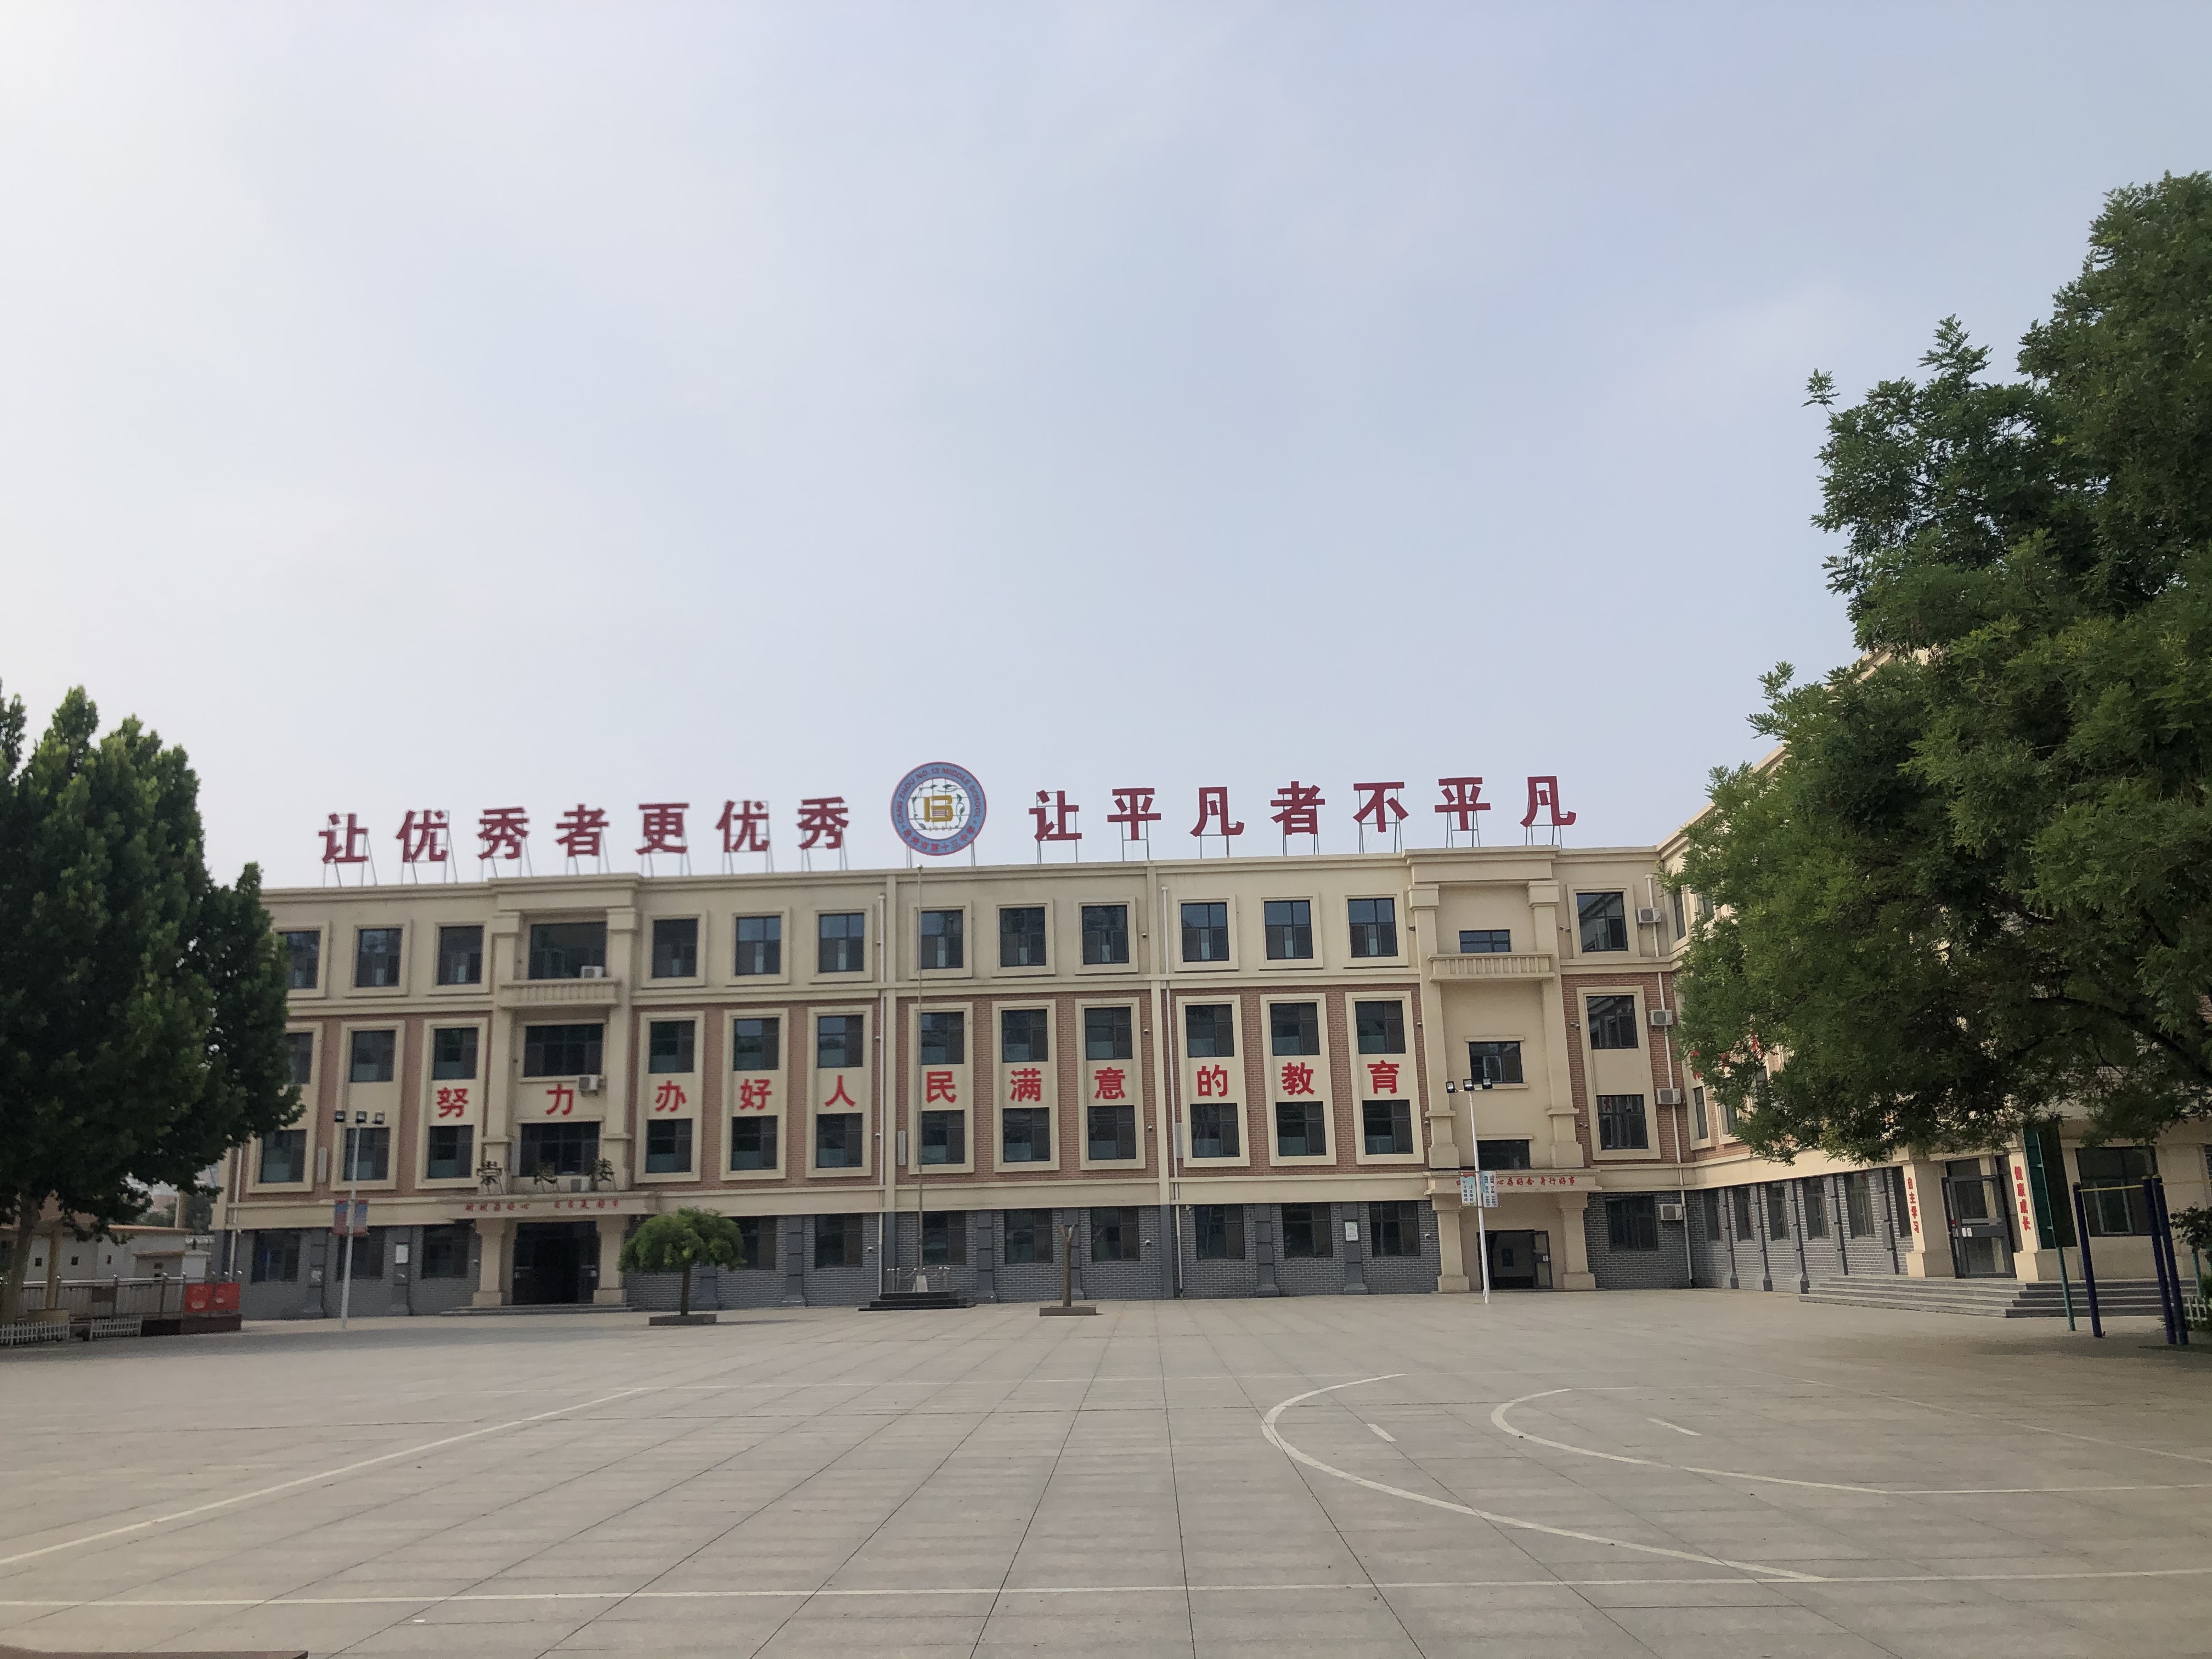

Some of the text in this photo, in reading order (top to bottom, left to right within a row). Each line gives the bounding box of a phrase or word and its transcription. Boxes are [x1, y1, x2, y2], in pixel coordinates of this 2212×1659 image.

[942, 767, 971, 785] MIDDLE
[969, 785, 981, 817] SCHOOL
[1030, 776, 1576, 841] 让平凡者不平凡
[319, 797, 849, 864] 让优秀者更优秀
[437, 1059, 1400, 1118] 努力办好人民满意的教育
[2014, 1165, 2031, 1232] 健康成长
